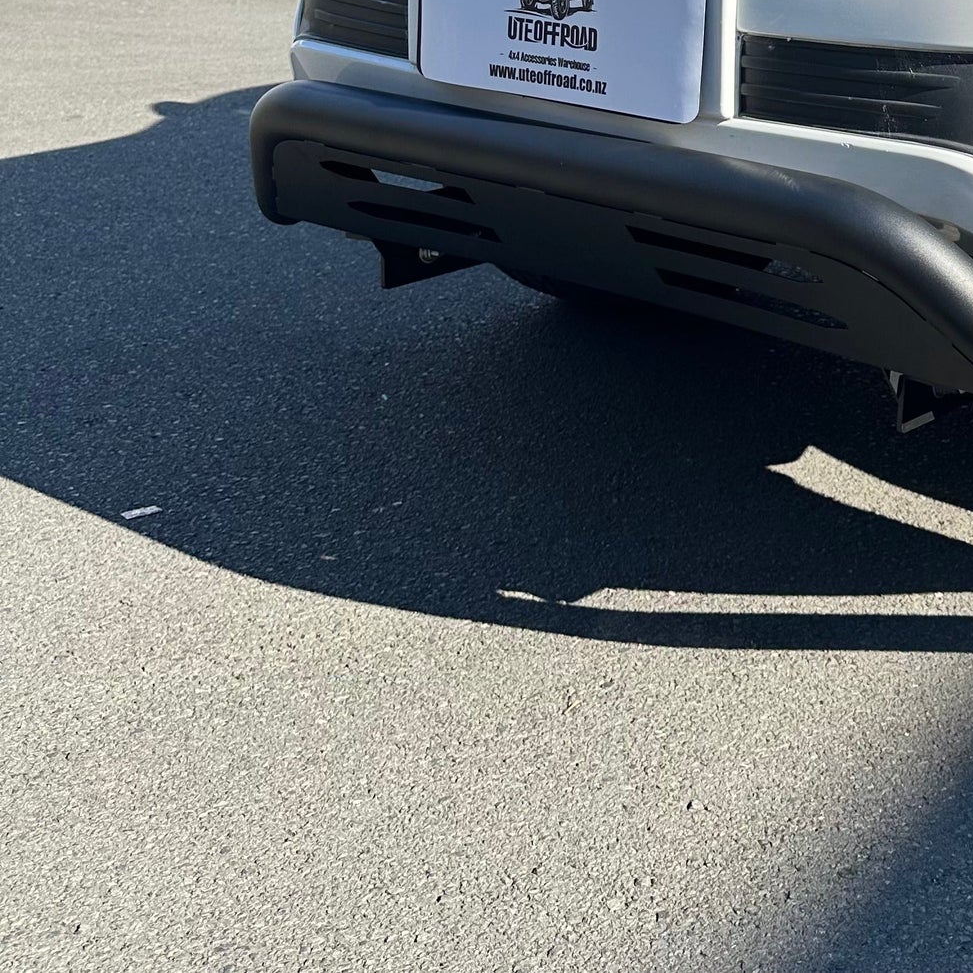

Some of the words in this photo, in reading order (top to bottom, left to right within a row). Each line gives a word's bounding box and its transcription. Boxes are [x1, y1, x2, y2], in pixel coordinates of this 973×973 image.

[508, 50, 520, 61] 4x4
[521, 52, 557, 67] Accessories
[558, 57, 591, 72] Warehouse
[489, 64, 607, 95] www.uteoffroad.co.nz
